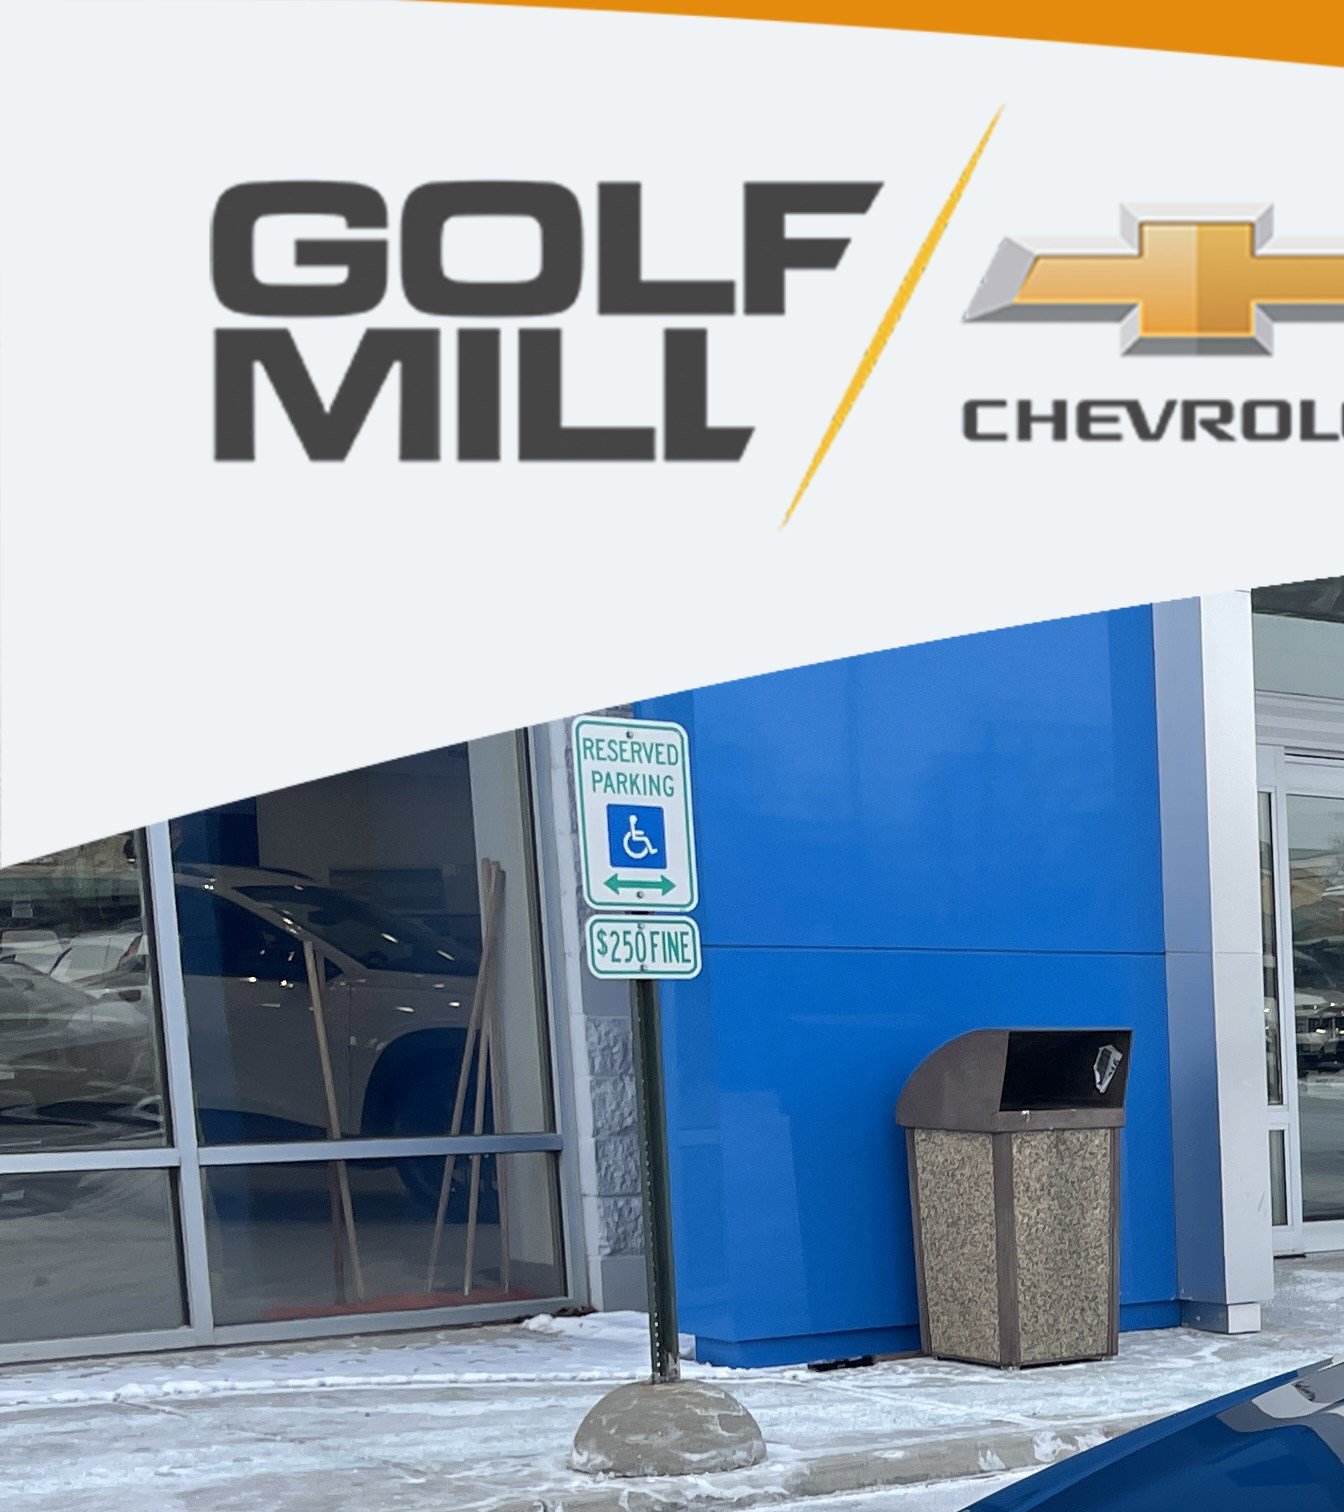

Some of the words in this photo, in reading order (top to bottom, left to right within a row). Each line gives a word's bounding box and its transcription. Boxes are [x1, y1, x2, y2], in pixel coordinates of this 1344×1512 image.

[582, 737, 679, 766] RESERVED
[591, 770, 675, 797] PARKING
[596, 928, 647, 964] $250
[650, 931, 692, 964] FINE
